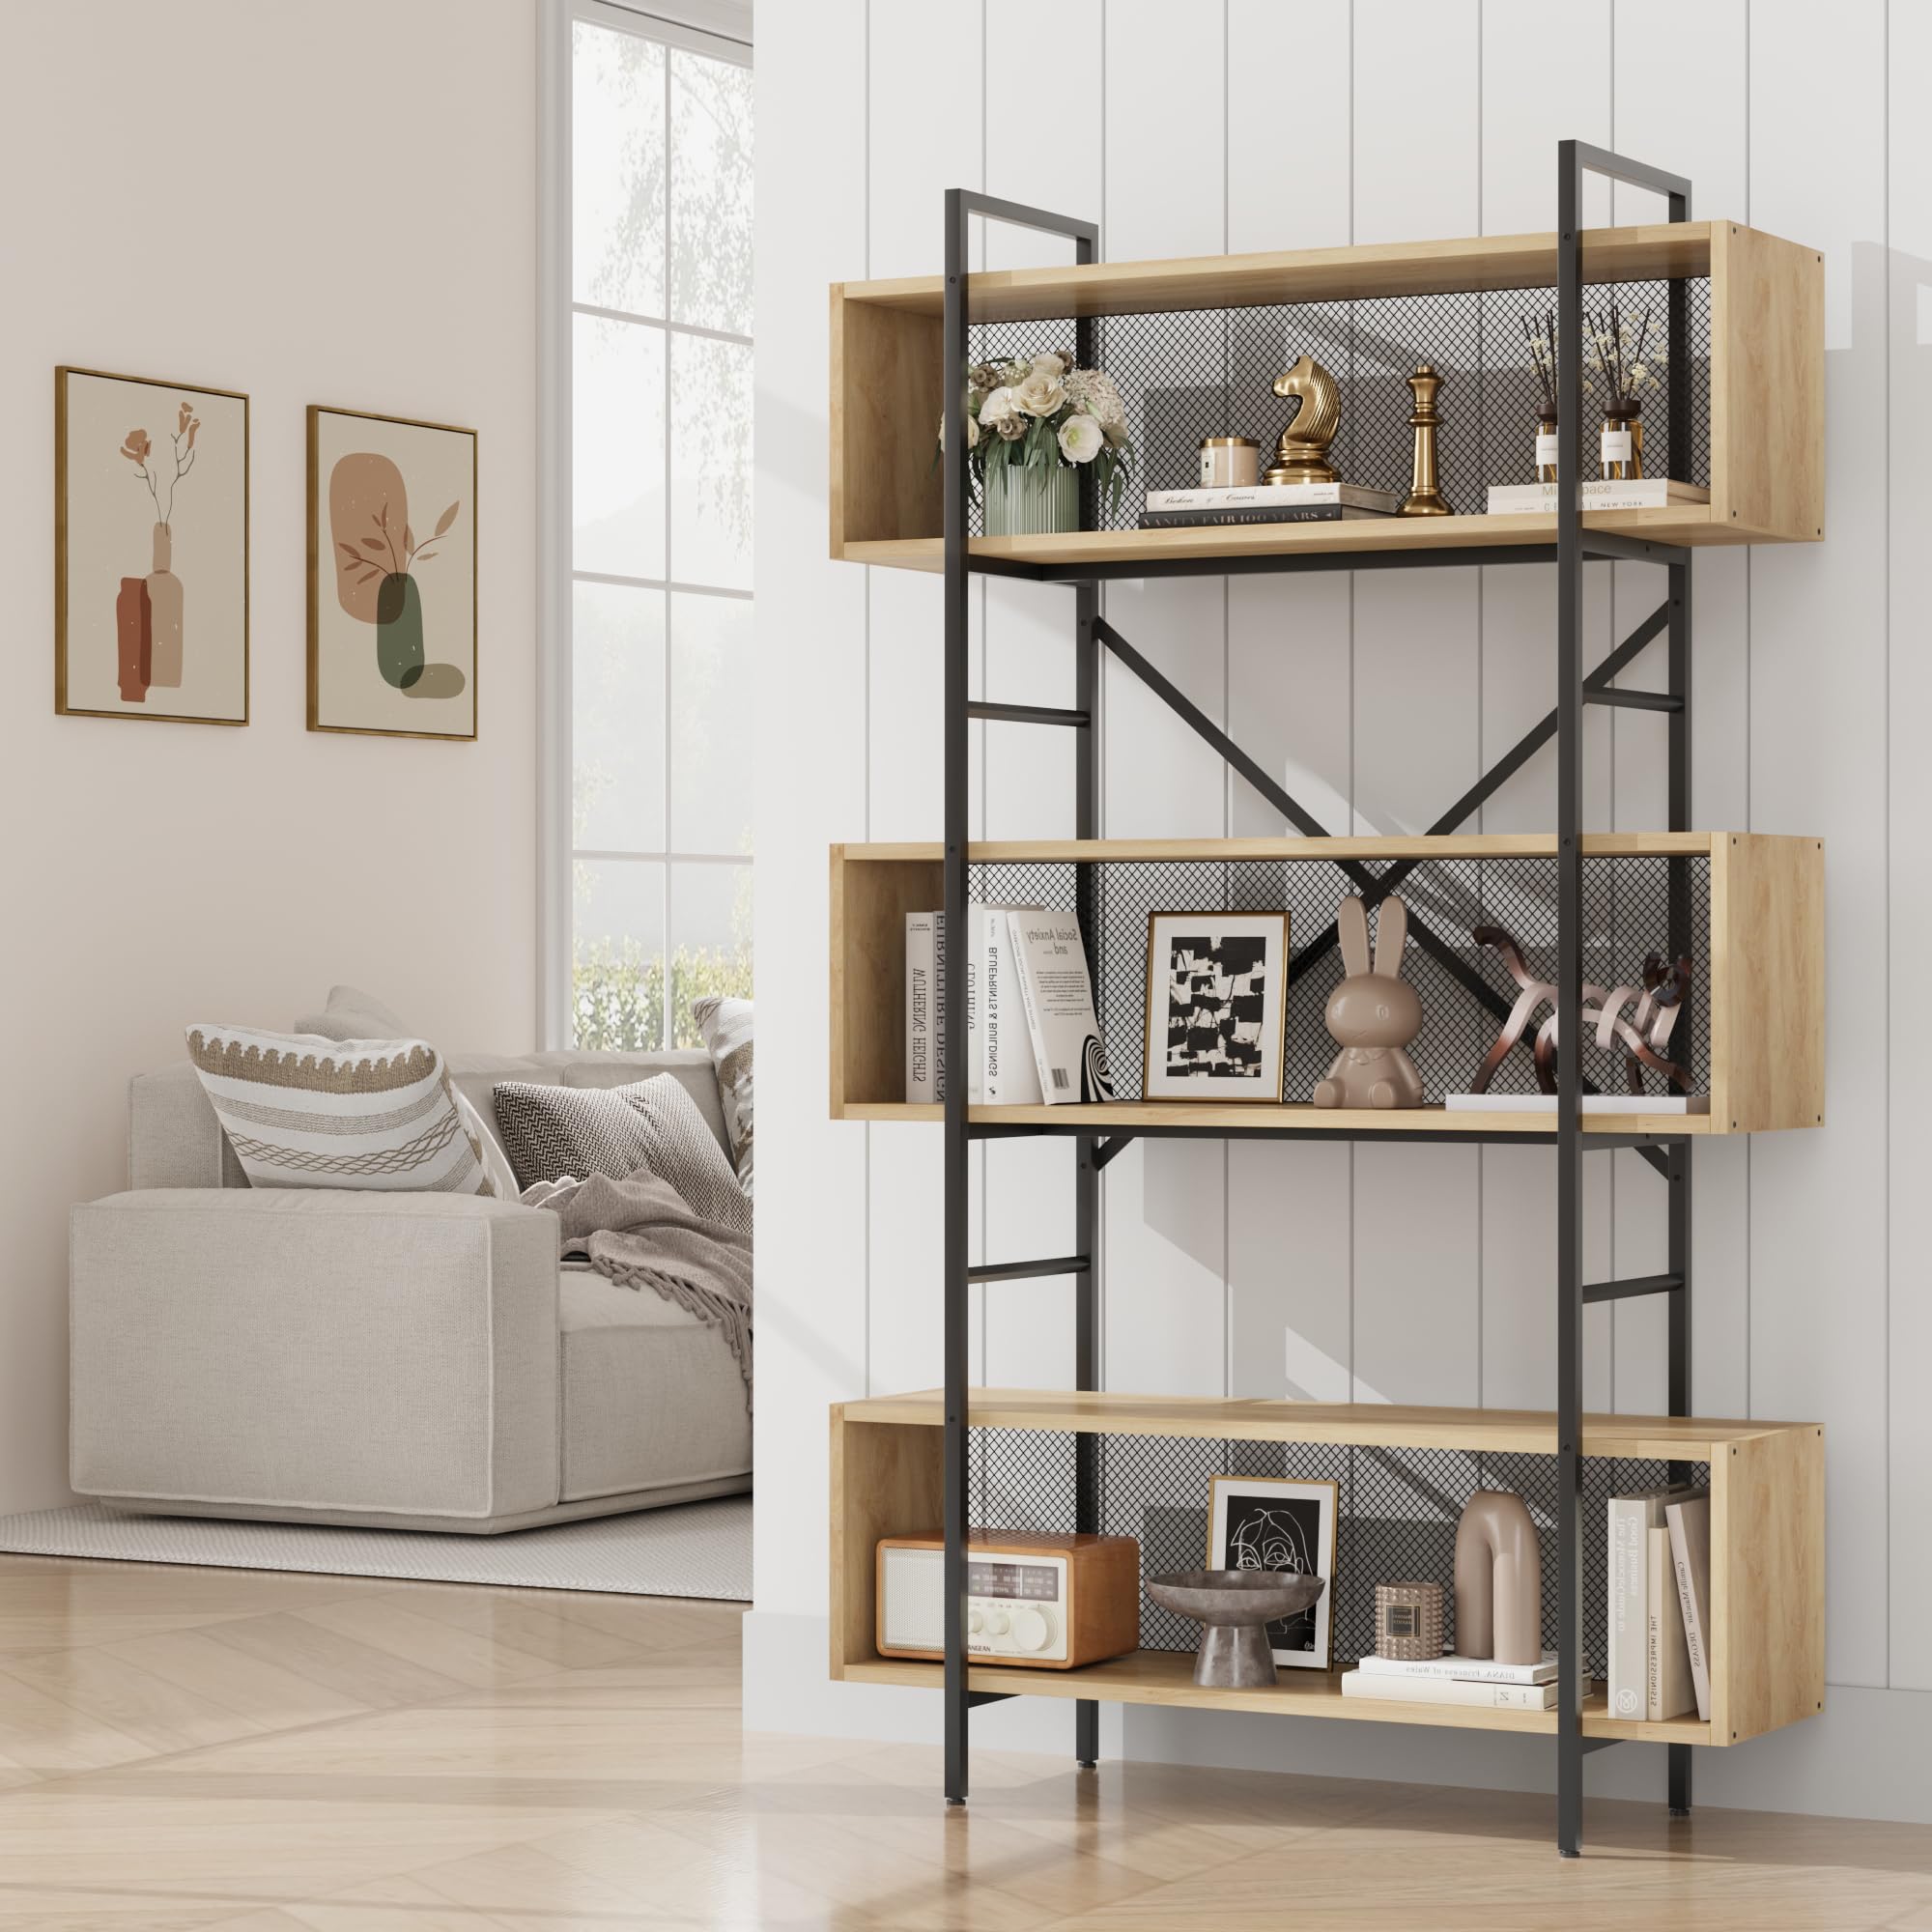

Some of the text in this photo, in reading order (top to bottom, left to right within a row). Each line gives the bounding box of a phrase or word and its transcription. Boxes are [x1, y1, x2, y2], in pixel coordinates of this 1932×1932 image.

[1143, 510, 1320, 527] VANITY FAIR 100 YEARS
